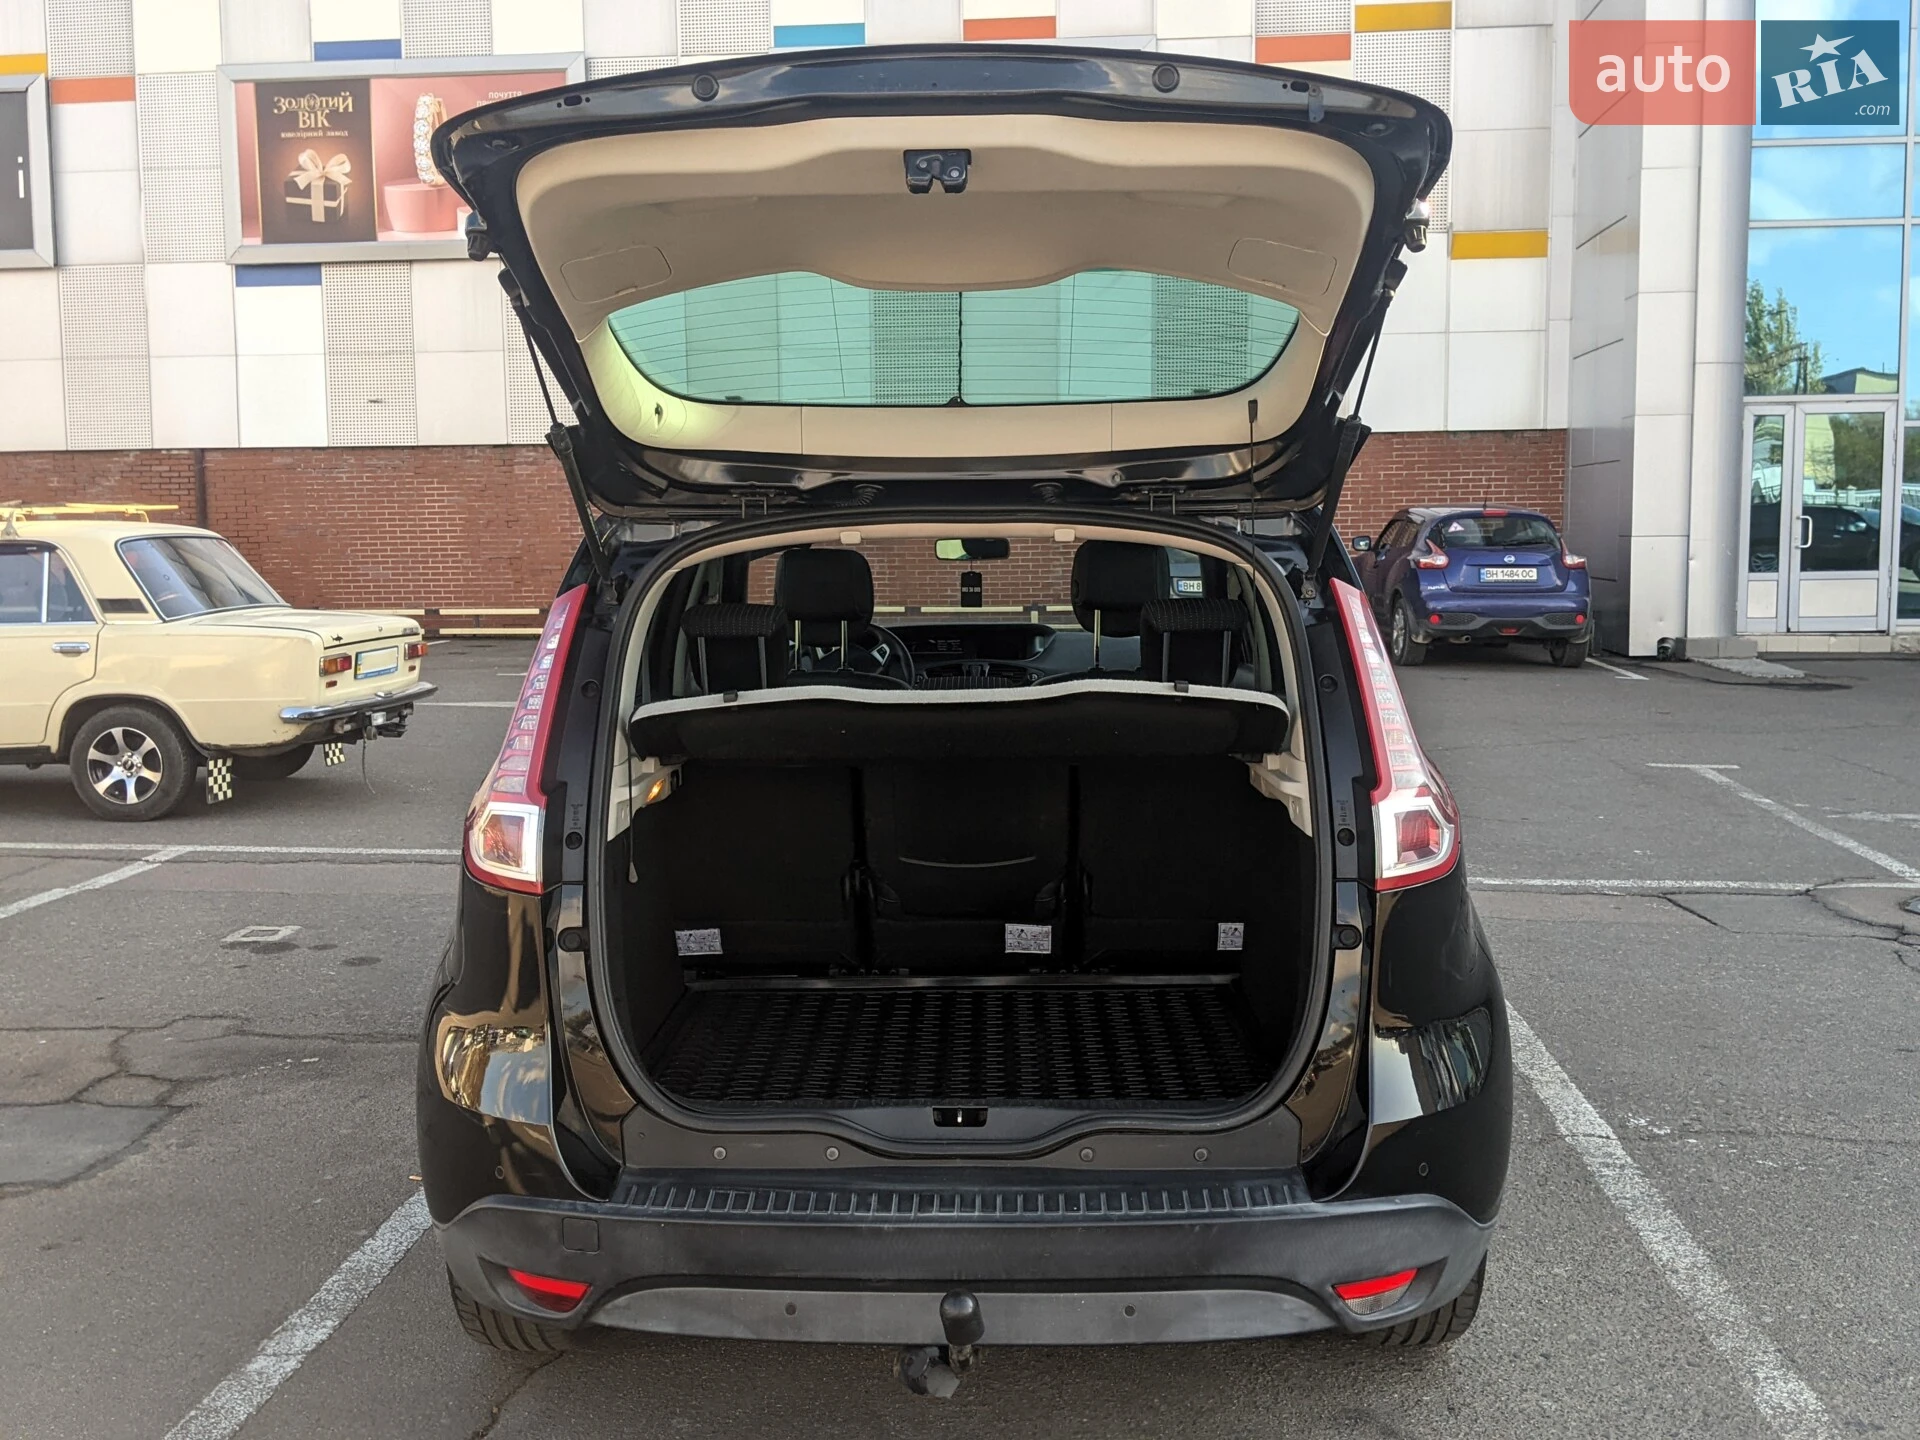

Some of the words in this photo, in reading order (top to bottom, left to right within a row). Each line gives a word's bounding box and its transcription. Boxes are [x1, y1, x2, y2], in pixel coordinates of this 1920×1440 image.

[298, 109, 332, 129] ВІК
[1485, 569, 1498, 579] BH
[1501, 569, 1520, 579] 1484
[1521, 569, 1534, 579] OC
[1183, 582, 1195, 591] BH
